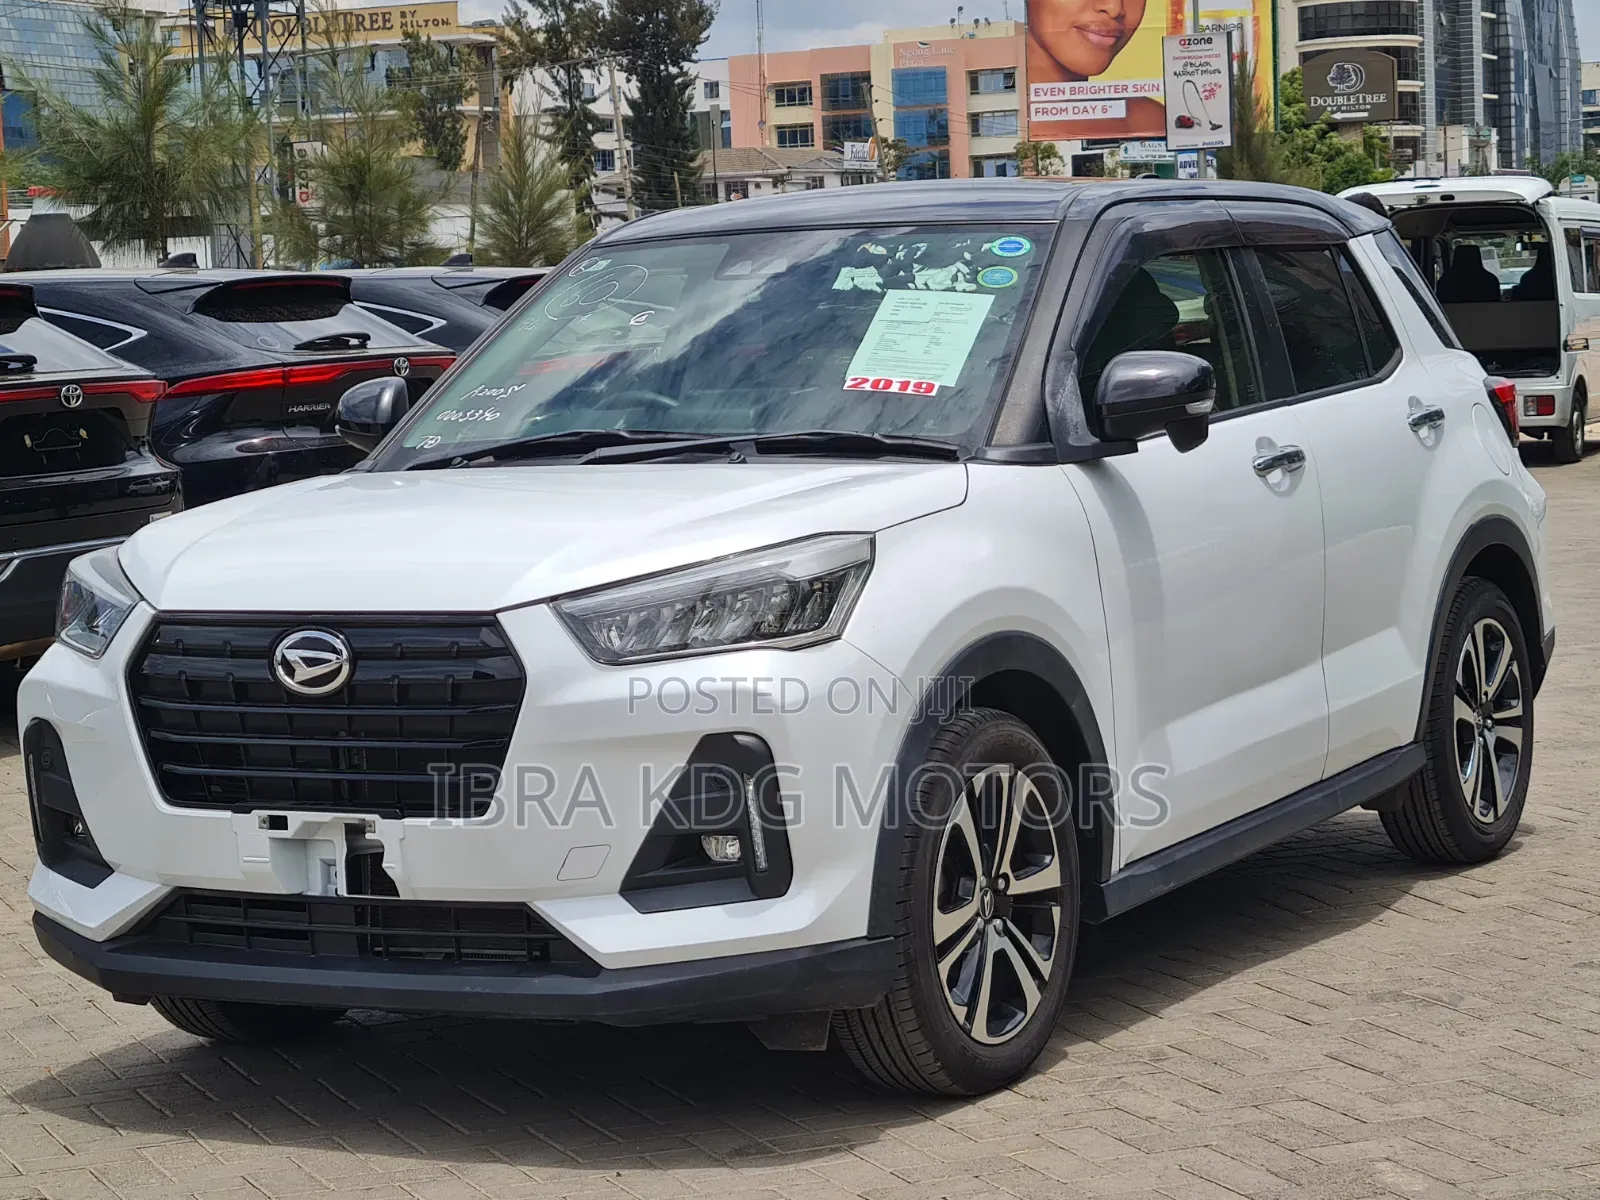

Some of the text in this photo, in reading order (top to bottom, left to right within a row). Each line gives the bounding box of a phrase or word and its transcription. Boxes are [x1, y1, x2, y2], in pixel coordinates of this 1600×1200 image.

[400, 10, 417, 19] BY
[1179, 36, 1213, 46] azone
[900, 47, 930, 59] Ngong
[1034, 83, 1160, 97] EVEN BRIGHTER SKIN
[1034, 107, 1068, 116] FROM
[1072, 105, 1097, 115] DAY
[846, 377, 936, 394] 2019
[288, 403, 331, 412] HARRIER
